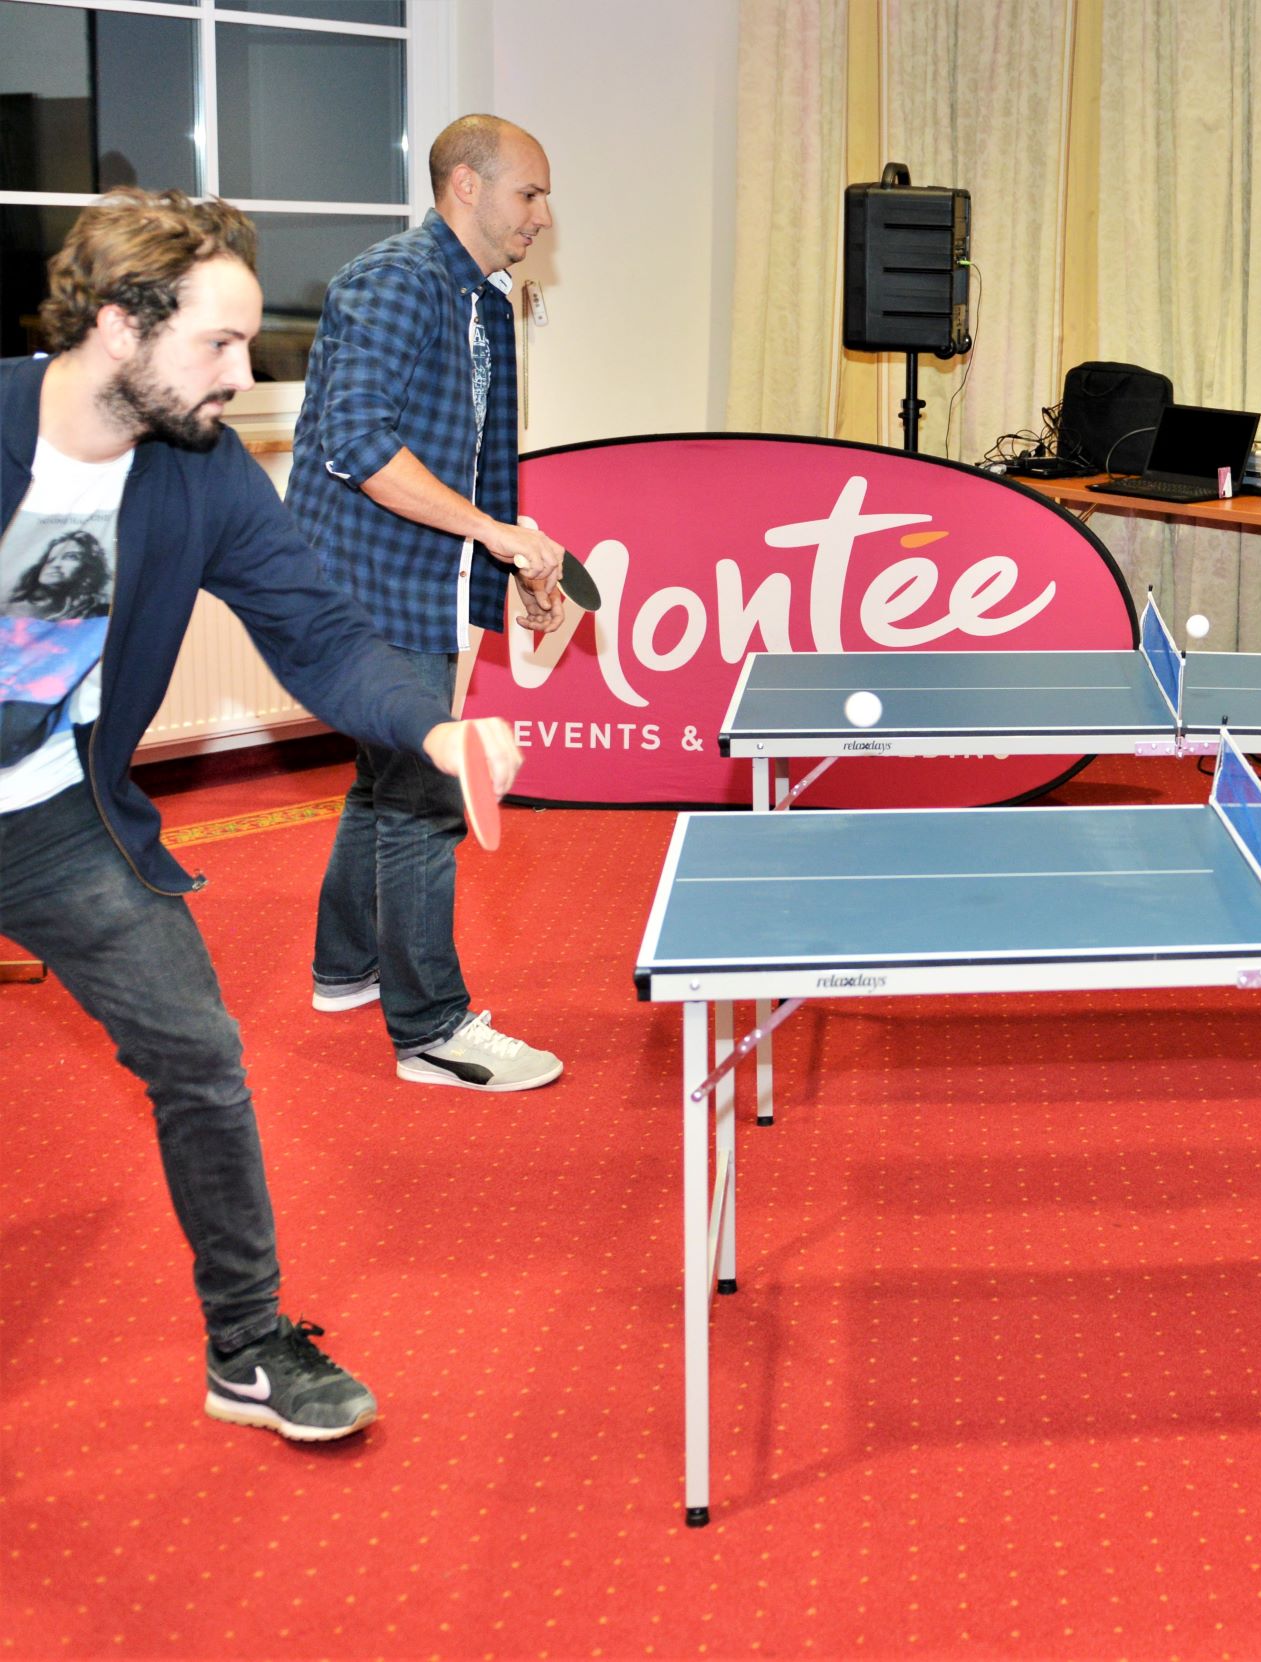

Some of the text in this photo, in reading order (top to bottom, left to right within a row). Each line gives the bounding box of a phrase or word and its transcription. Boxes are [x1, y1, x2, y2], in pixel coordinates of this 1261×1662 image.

[514, 720, 704, 751] EVENTS &
[843, 740, 893, 755] relaxdays
[816, 973, 887, 994] relaxdays
